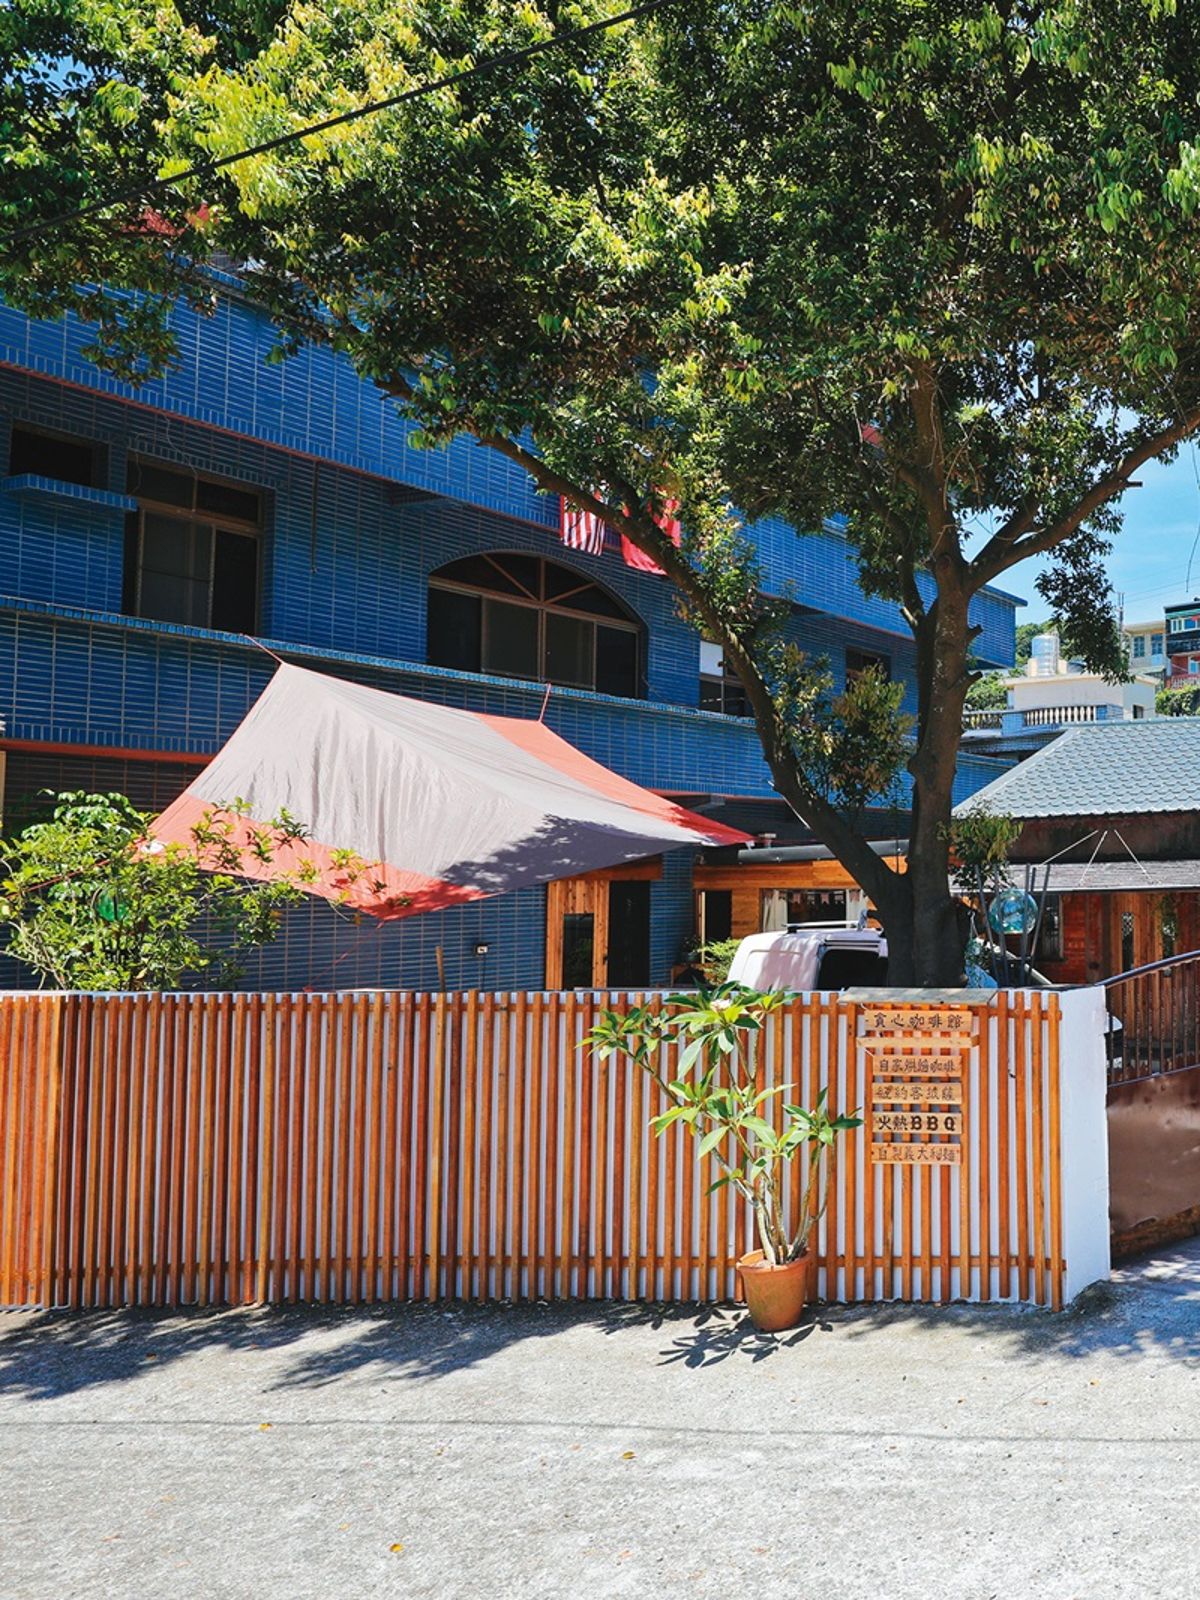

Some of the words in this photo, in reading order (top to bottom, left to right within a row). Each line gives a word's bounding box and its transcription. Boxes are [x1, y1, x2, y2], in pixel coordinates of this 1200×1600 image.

[873, 1012, 963, 1030] 貪心咖啡館
